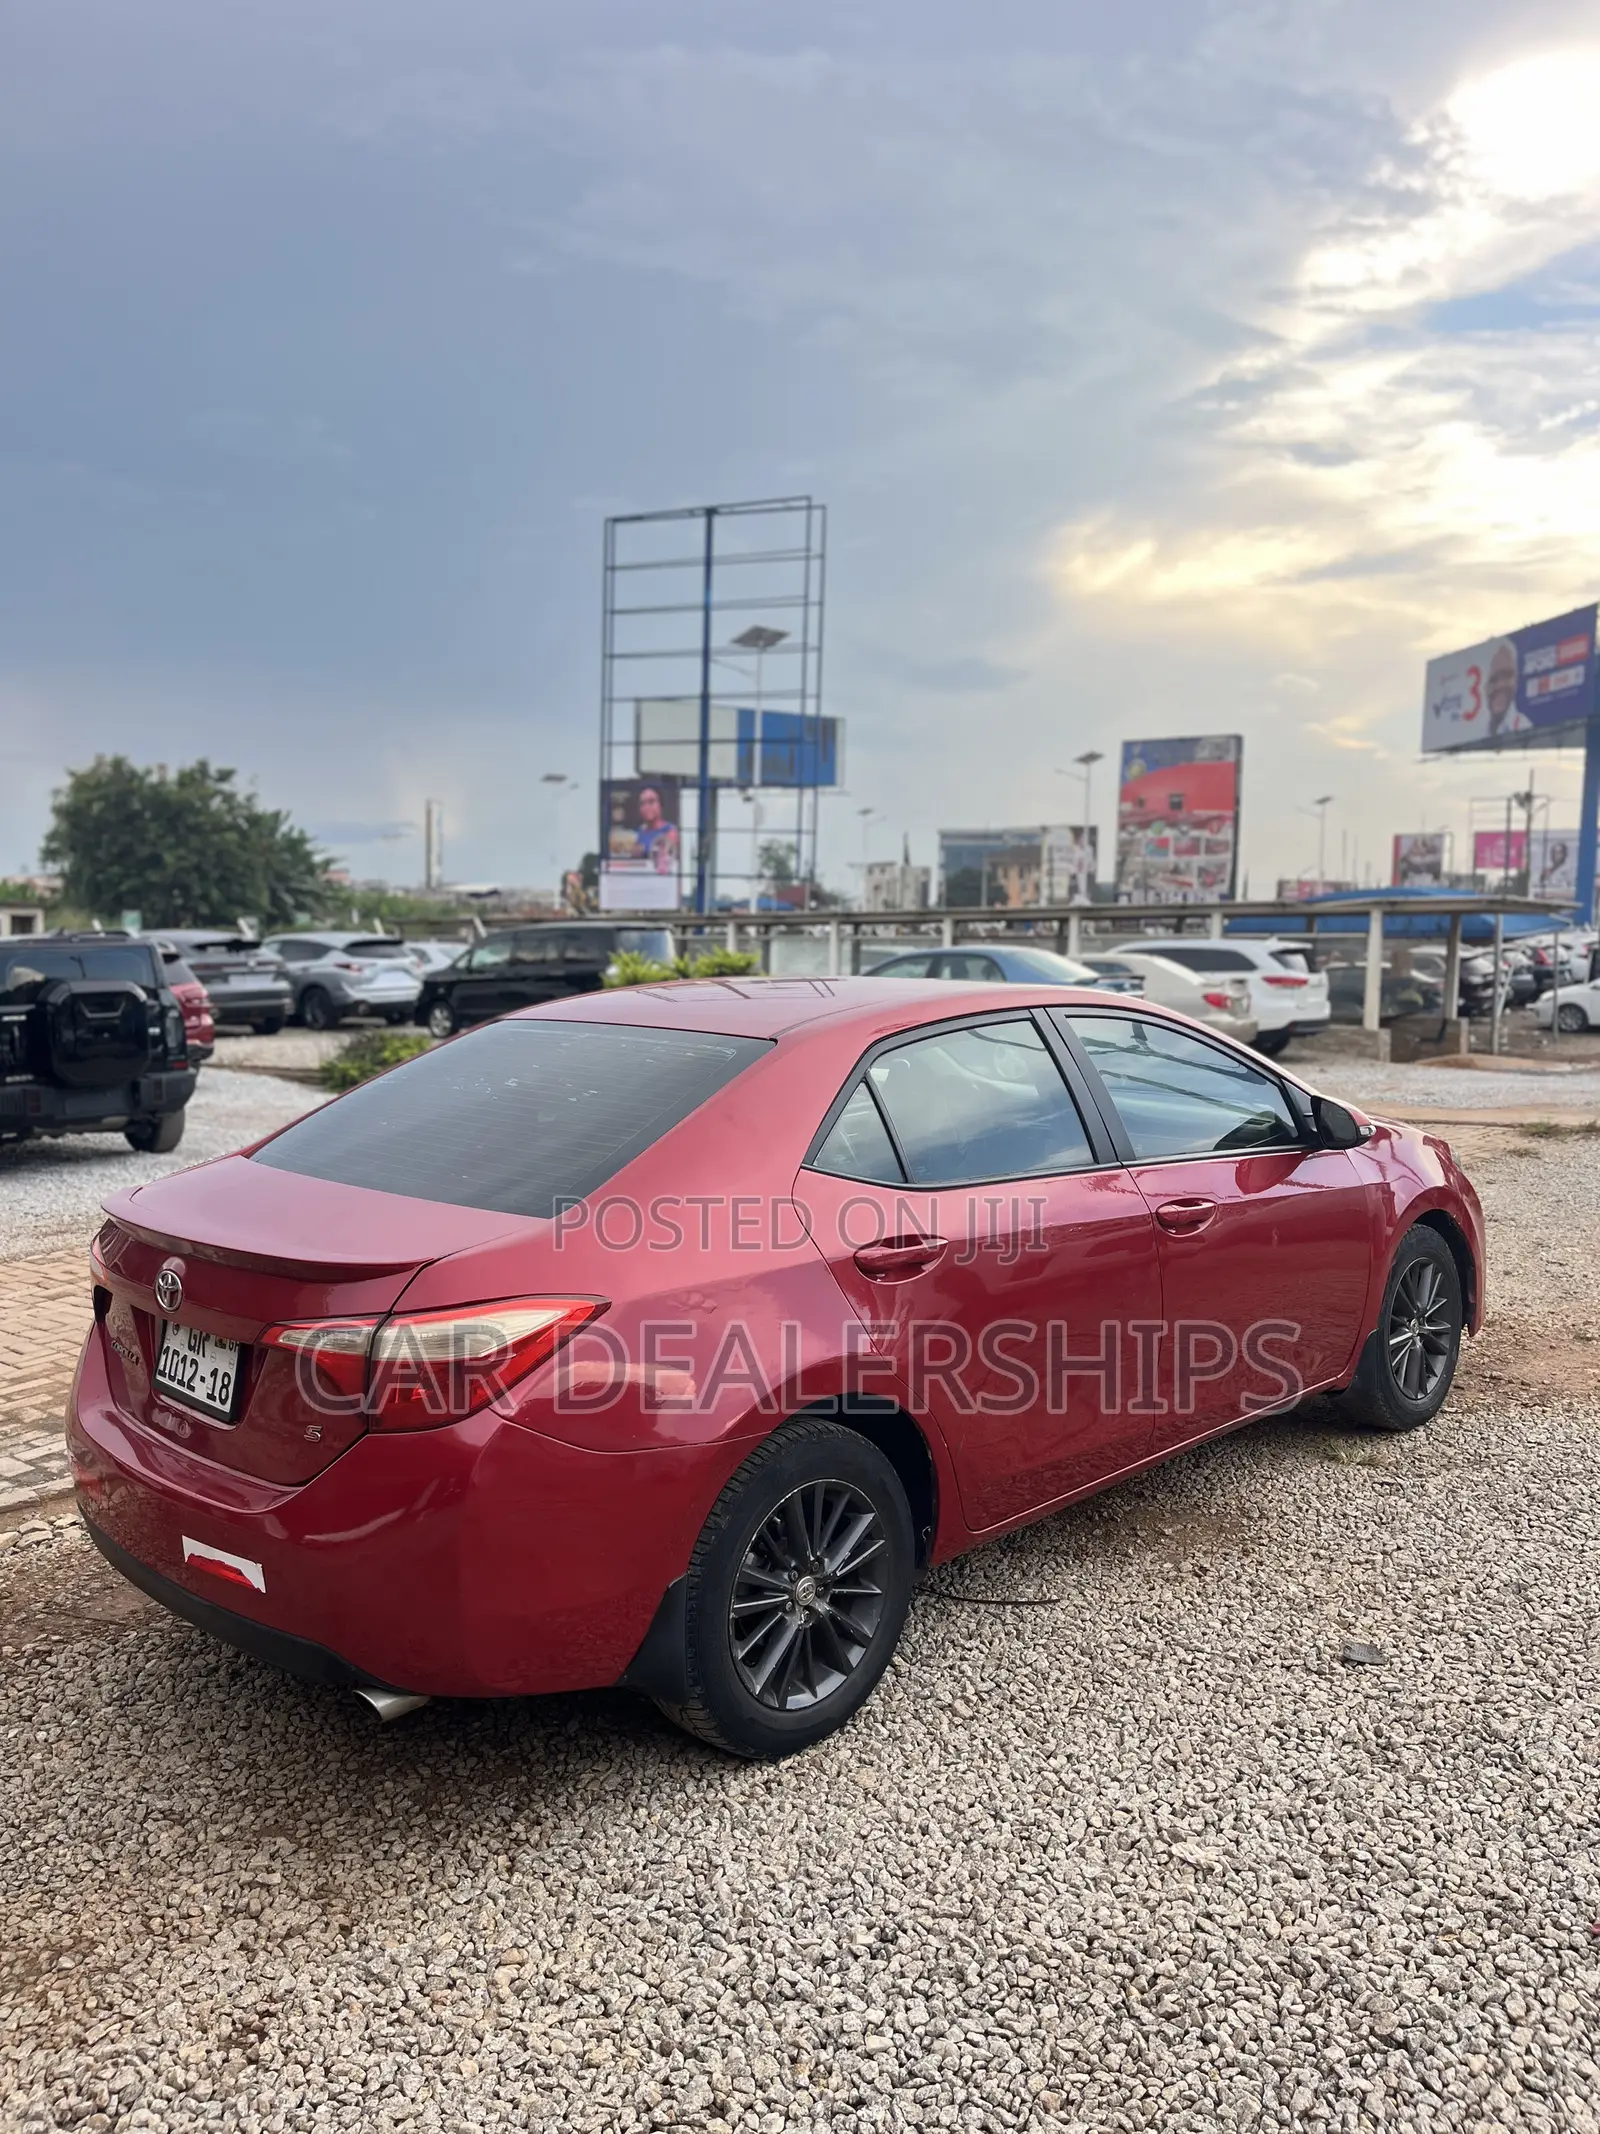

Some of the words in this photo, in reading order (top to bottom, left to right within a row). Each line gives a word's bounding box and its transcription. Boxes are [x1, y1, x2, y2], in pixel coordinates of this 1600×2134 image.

[1463, 665, 1482, 721] 3
[157, 1345, 232, 1406] 1012-18
[303, 1425, 322, 1442] S
